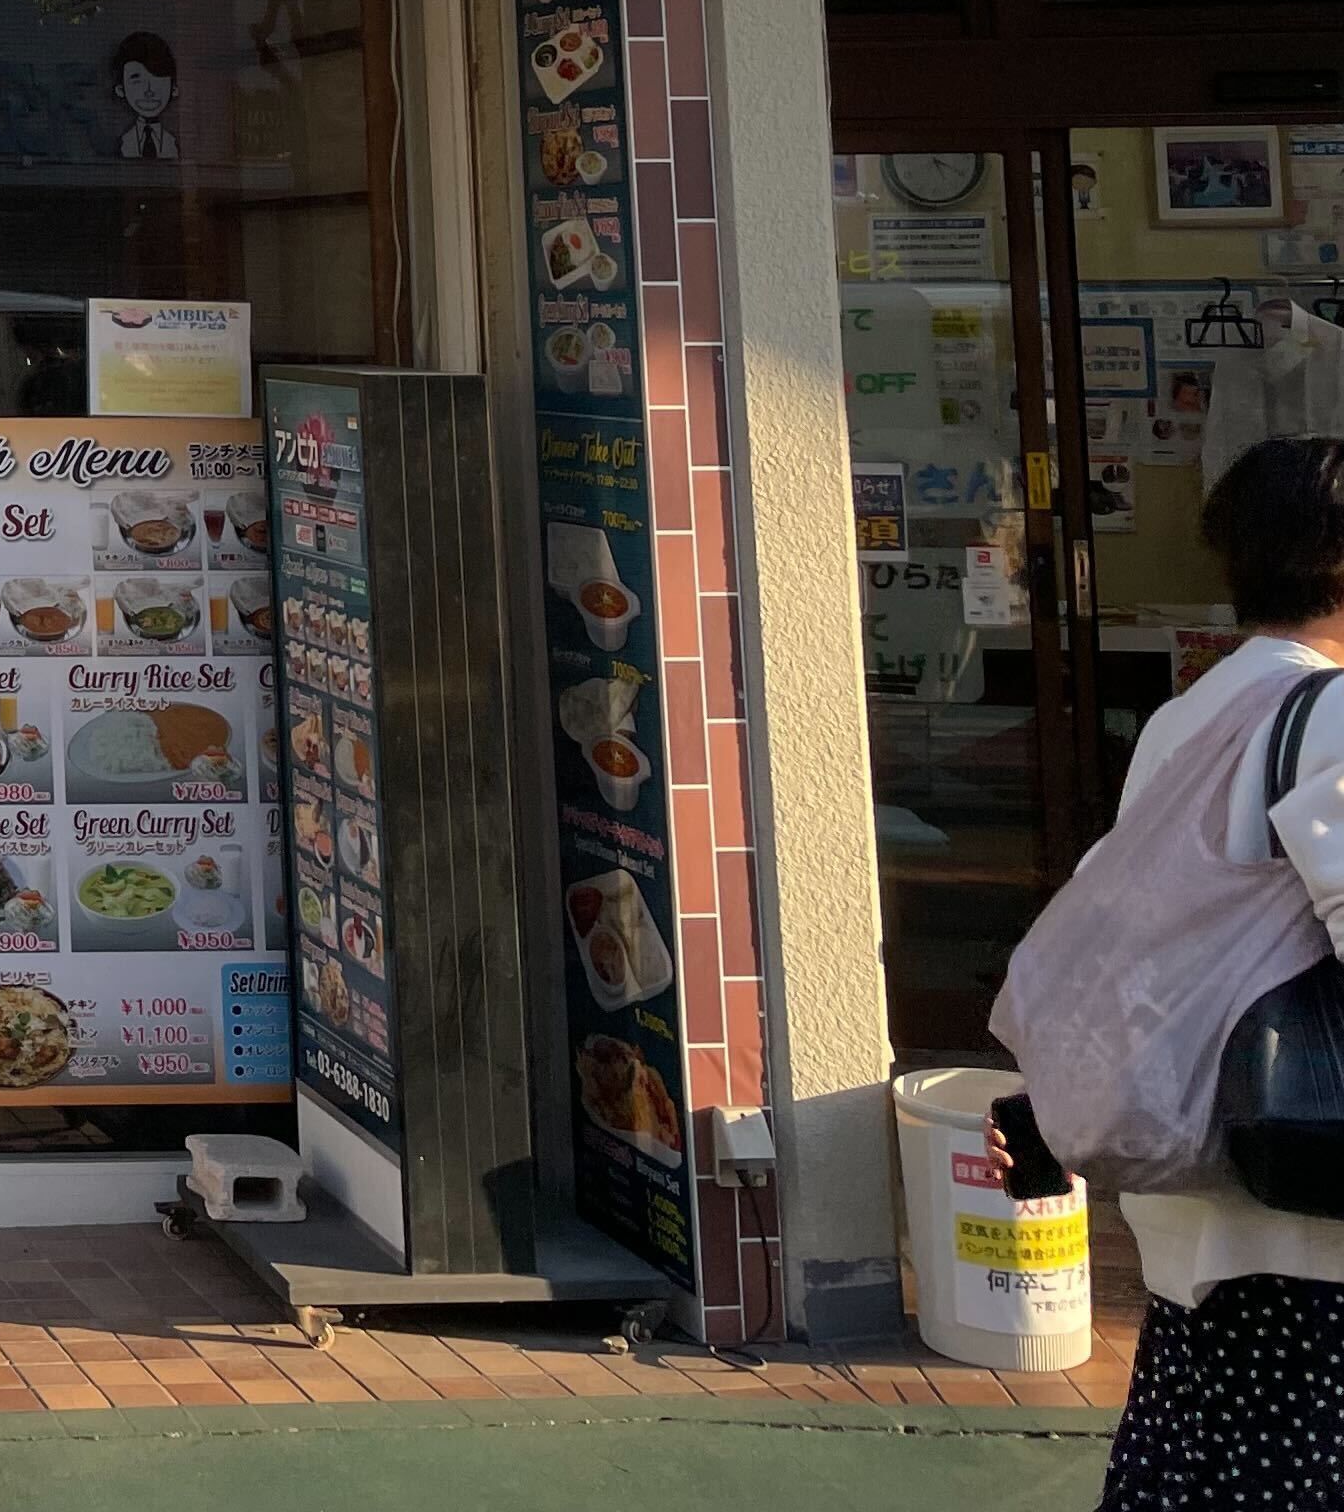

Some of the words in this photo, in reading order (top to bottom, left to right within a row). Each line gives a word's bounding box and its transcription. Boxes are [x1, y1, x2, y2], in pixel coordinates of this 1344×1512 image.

[156, 308, 227, 323] AMBIKA
[855, 373, 916, 395] OFF
[274, 429, 321, 469] アンビカ
[29, 439, 170, 486] Menu
[1, 504, 55, 541] Set
[68, 664, 138, 696] Curry
[144, 663, 194, 690] Rice
[197, 663, 235, 690] Set
[173, 784, 225, 800] ¥750
[14, 810, 50, 837] Set
[74, 809, 130, 843] Green
[135, 809, 197, 844] Curry
[201, 809, 235, 836] Set
[178, 932, 233, 949] ¥950
[230, 972, 255, 994] Set
[256, 972, 289, 994] Drin
[68, 1000, 97, 1010] チキン
[120, 998, 187, 1017] ¥1,000
[122, 1026, 188, 1045] ¥1,100
[140, 1055, 190, 1073] ¥950
[317, 1049, 392, 1123] 03-6388-1830
